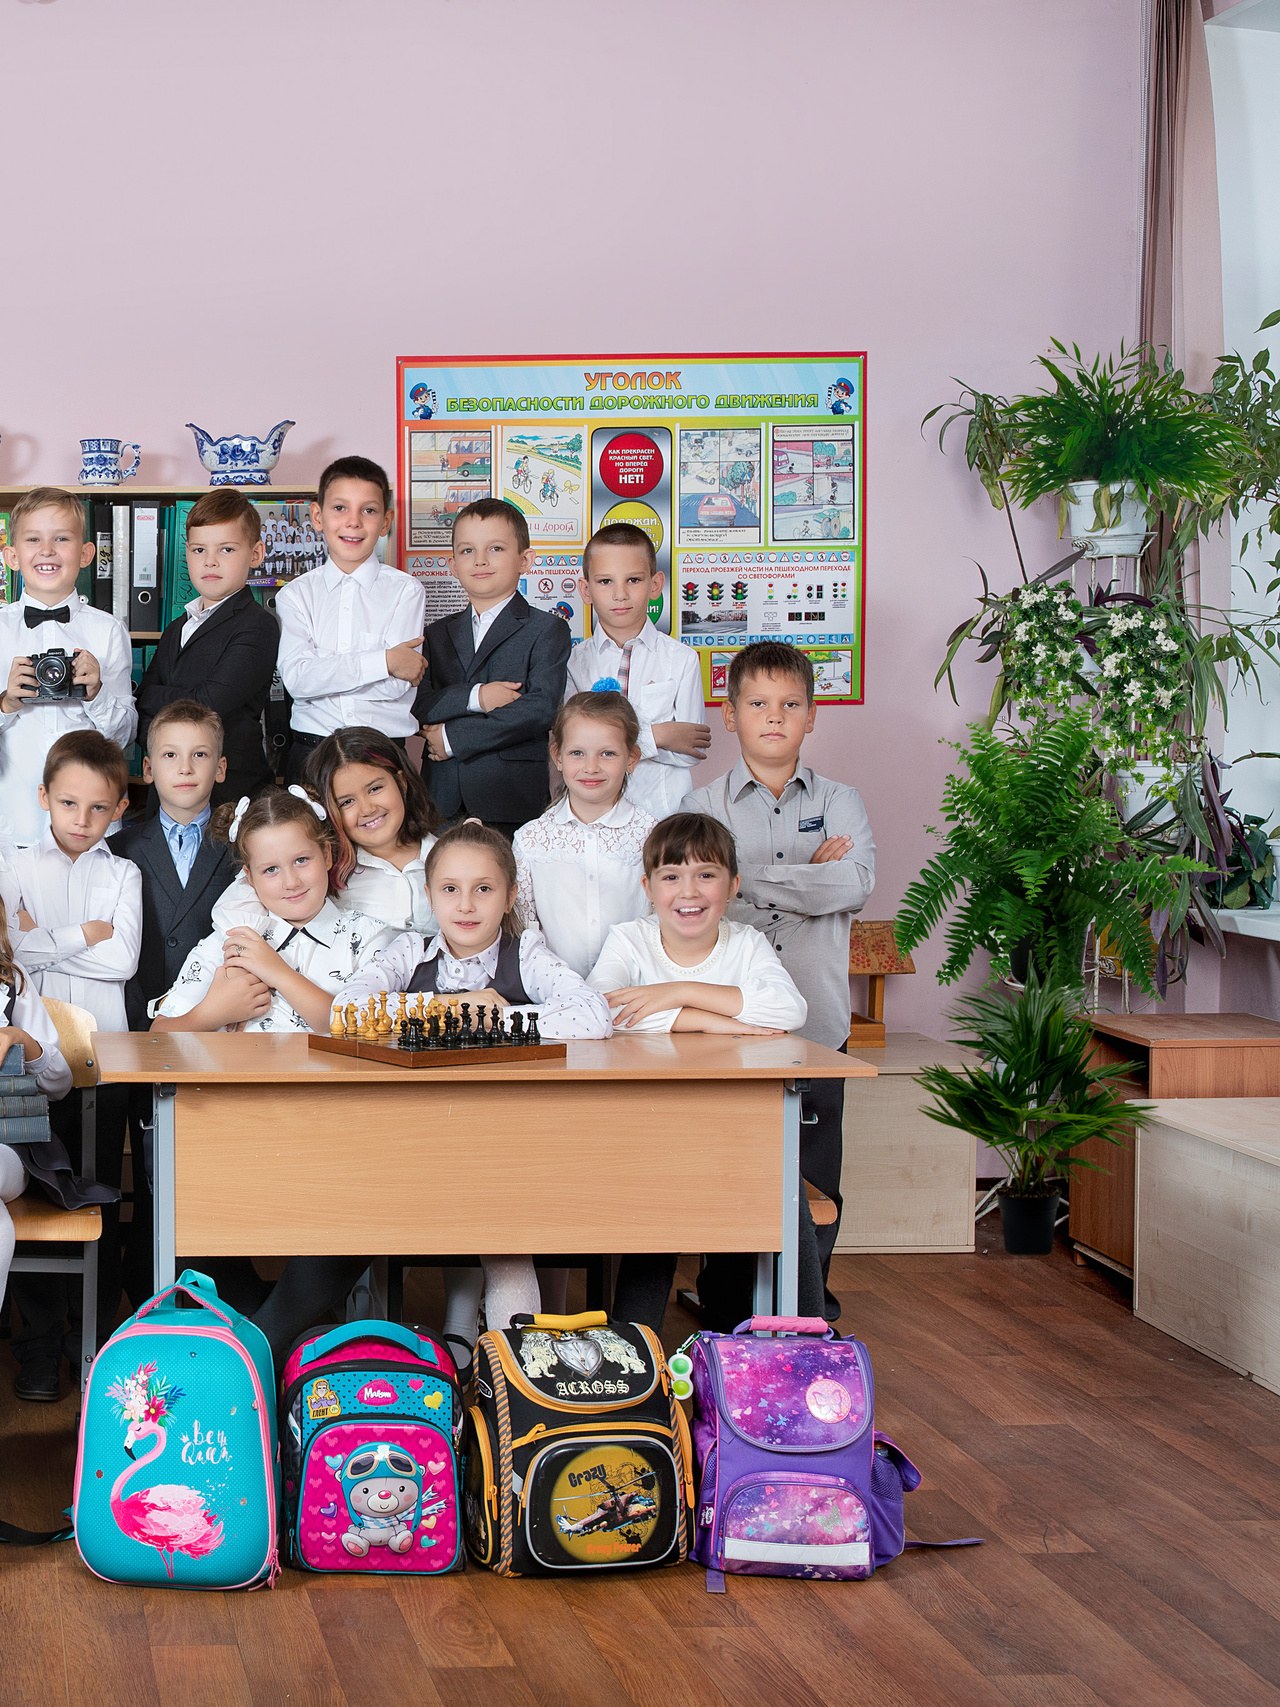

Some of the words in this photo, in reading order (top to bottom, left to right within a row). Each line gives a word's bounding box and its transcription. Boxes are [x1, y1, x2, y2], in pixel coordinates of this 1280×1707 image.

[584, 372, 682, 391] УГОЛОК
[446, 396, 585, 412] БЕЗОПАСНОСТИ
[589, 394, 710, 411] ДОРОЖНОГО
[715, 393, 819, 409] ДВИЖЕНИЯ
[619, 474, 644, 484] НЕТ!
[682, 566, 711, 574] ПЕРЕХОД
[711, 566, 743, 574] ПРОЕЗЖЕЙ
[743, 565, 763, 573] ЧАСТИ
[764, 565, 773, 573] НА
[556, 1379, 630, 1396] ACROSS
[568, 1463, 608, 1488] Crazy
